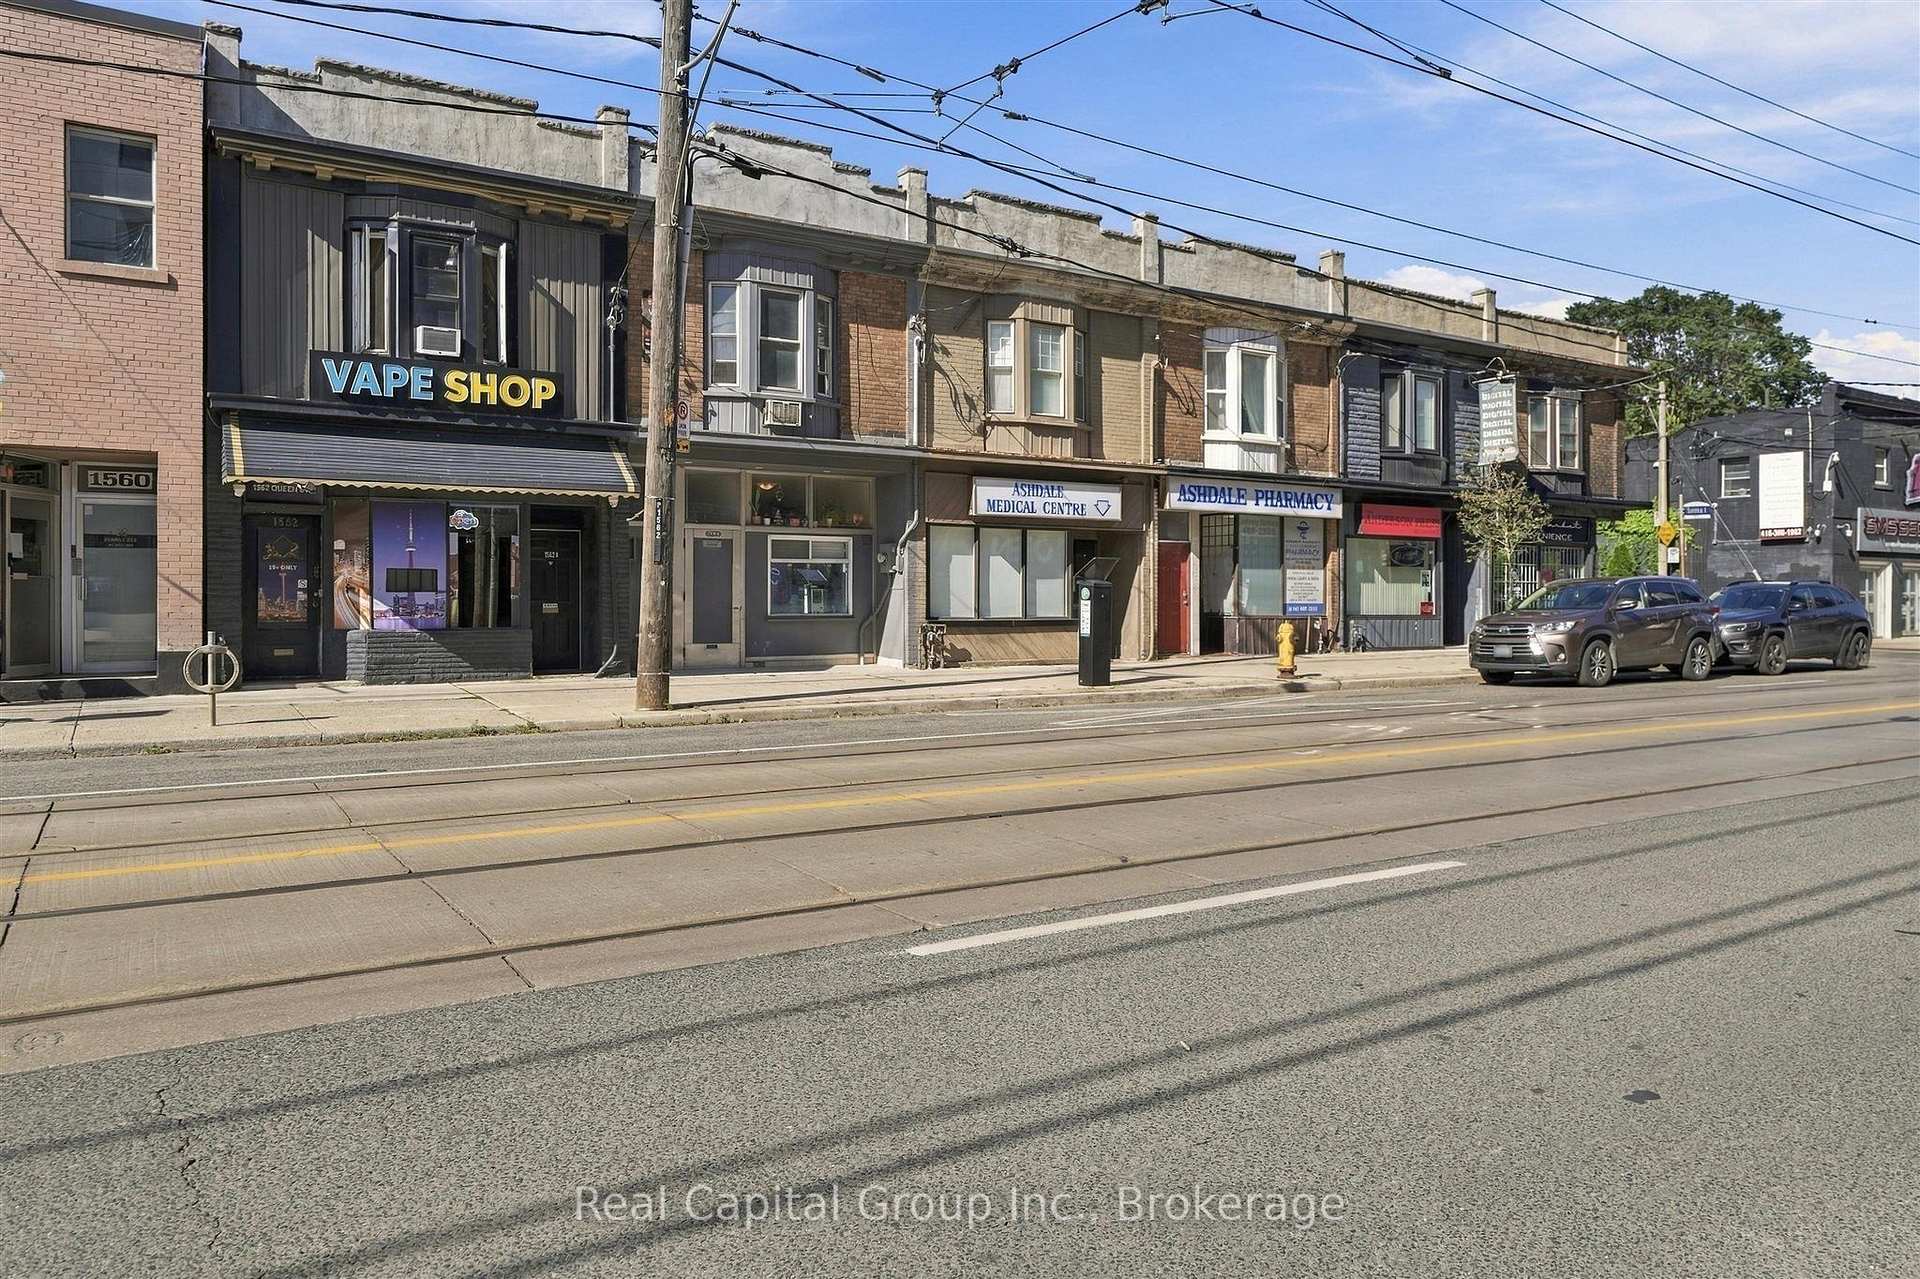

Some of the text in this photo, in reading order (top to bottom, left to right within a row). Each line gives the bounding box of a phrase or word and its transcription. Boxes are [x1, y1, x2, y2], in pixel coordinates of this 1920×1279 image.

[322, 358, 556, 409] VAPE SHOP
[1482, 390, 1512, 400] DIGITAL
[1482, 400, 1512, 410] DIGITAL
[1482, 409, 1512, 419] DIGITAL
[1483, 419, 1513, 429] DIGITAL
[1483, 428, 1513, 438] DIGITAL
[1483, 438, 1514, 447] DIGITAL
[89, 472, 151, 488] 1560
[1012, 482, 1064, 498] ASHDALE
[1177, 484, 1334, 511] ASHDALE PHARMACY
[986, 499, 1087, 516] MEDICAL CENTRE
